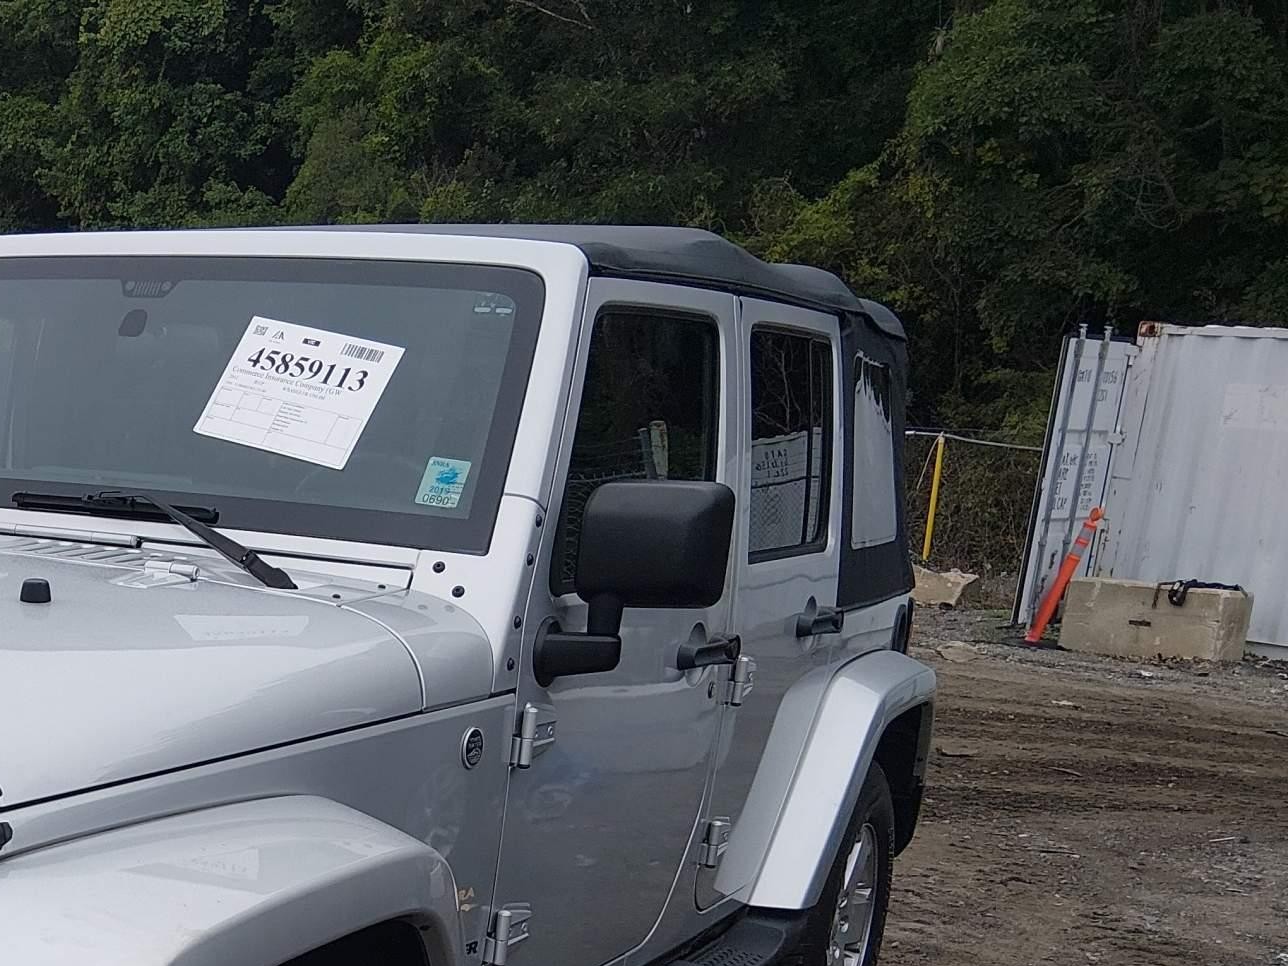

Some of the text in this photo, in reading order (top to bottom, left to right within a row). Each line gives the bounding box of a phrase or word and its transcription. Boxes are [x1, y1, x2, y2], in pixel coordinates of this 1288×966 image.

[232, 366, 265, 379] Commerce
[264, 373, 294, 386] Insurance
[294, 379, 325, 395] Company
[248, 347, 369, 392] 45859113
[422, 493, 449, 505] 0690
